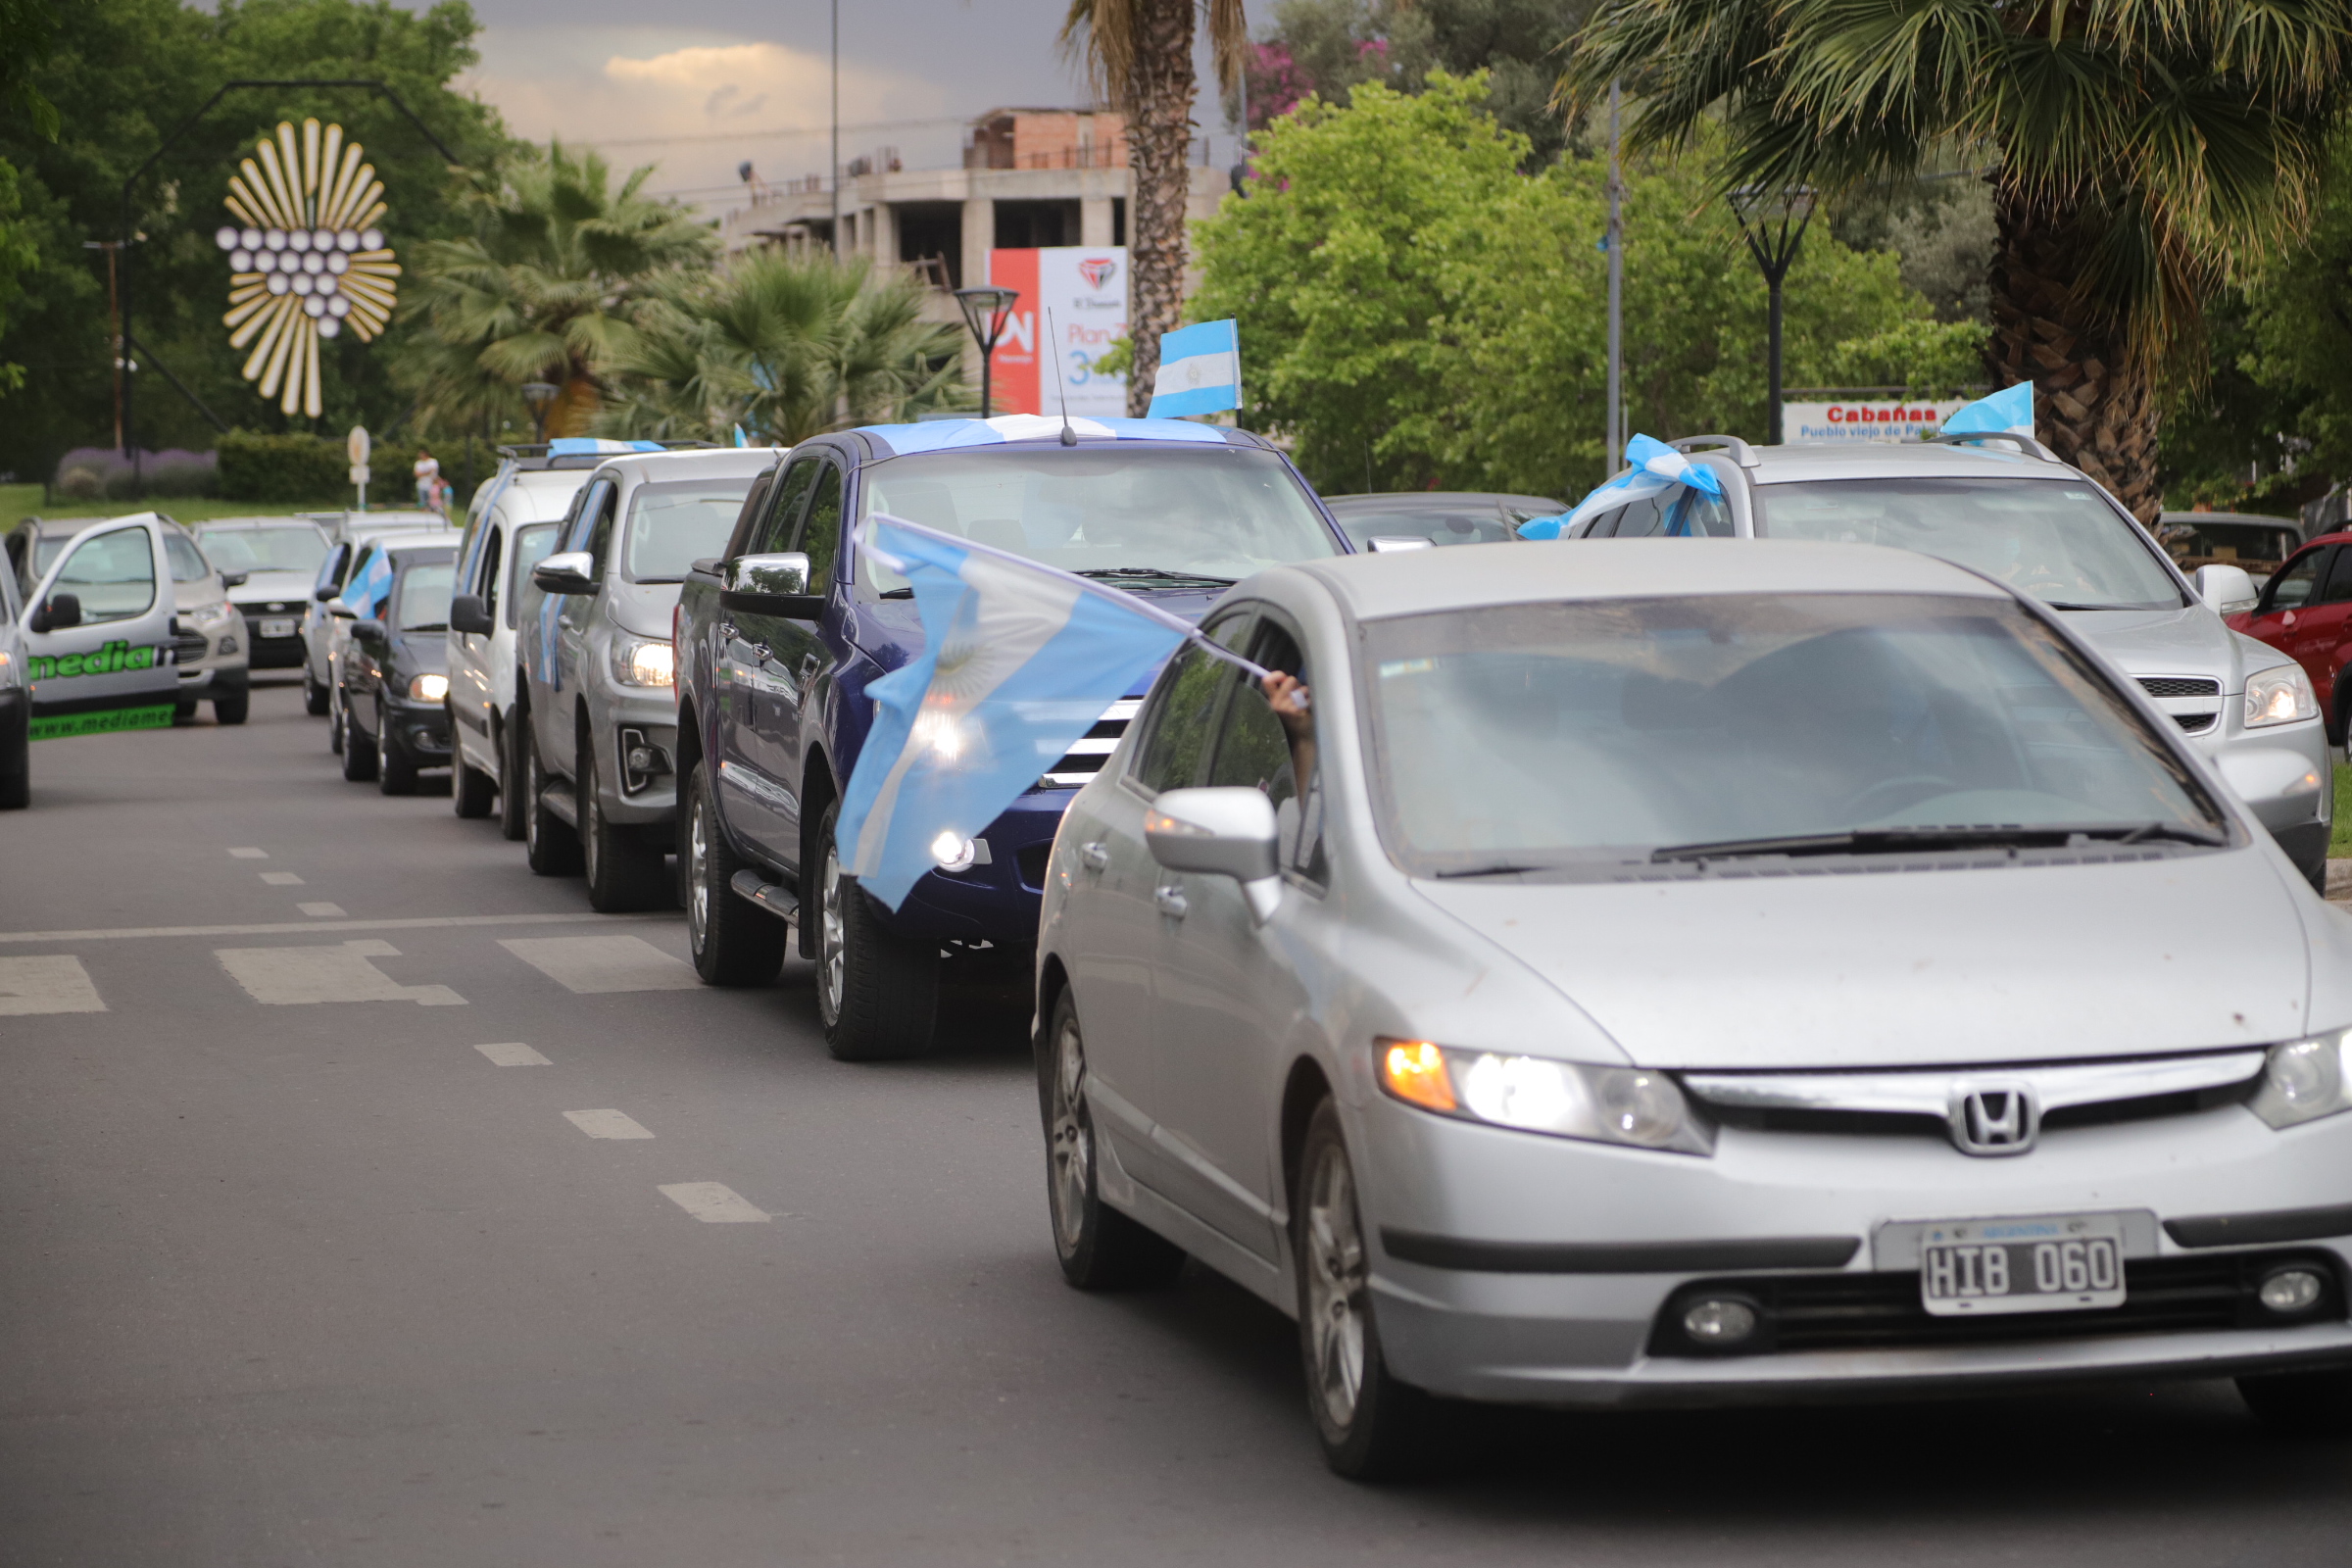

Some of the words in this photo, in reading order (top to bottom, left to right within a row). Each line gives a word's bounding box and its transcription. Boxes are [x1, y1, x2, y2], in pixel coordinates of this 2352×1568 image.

[1067, 322, 1111, 344] Plan
[1068, 350, 1090, 385] 3
[1827, 405, 1936, 422] Cabañas
[1800, 424, 1846, 437] Pueblo
[1849, 422, 1880, 438] viejo
[1885, 423, 1901, 436] de
[1929, 1246, 2010, 1297] HIB
[2034, 1240, 2116, 1293] 060
